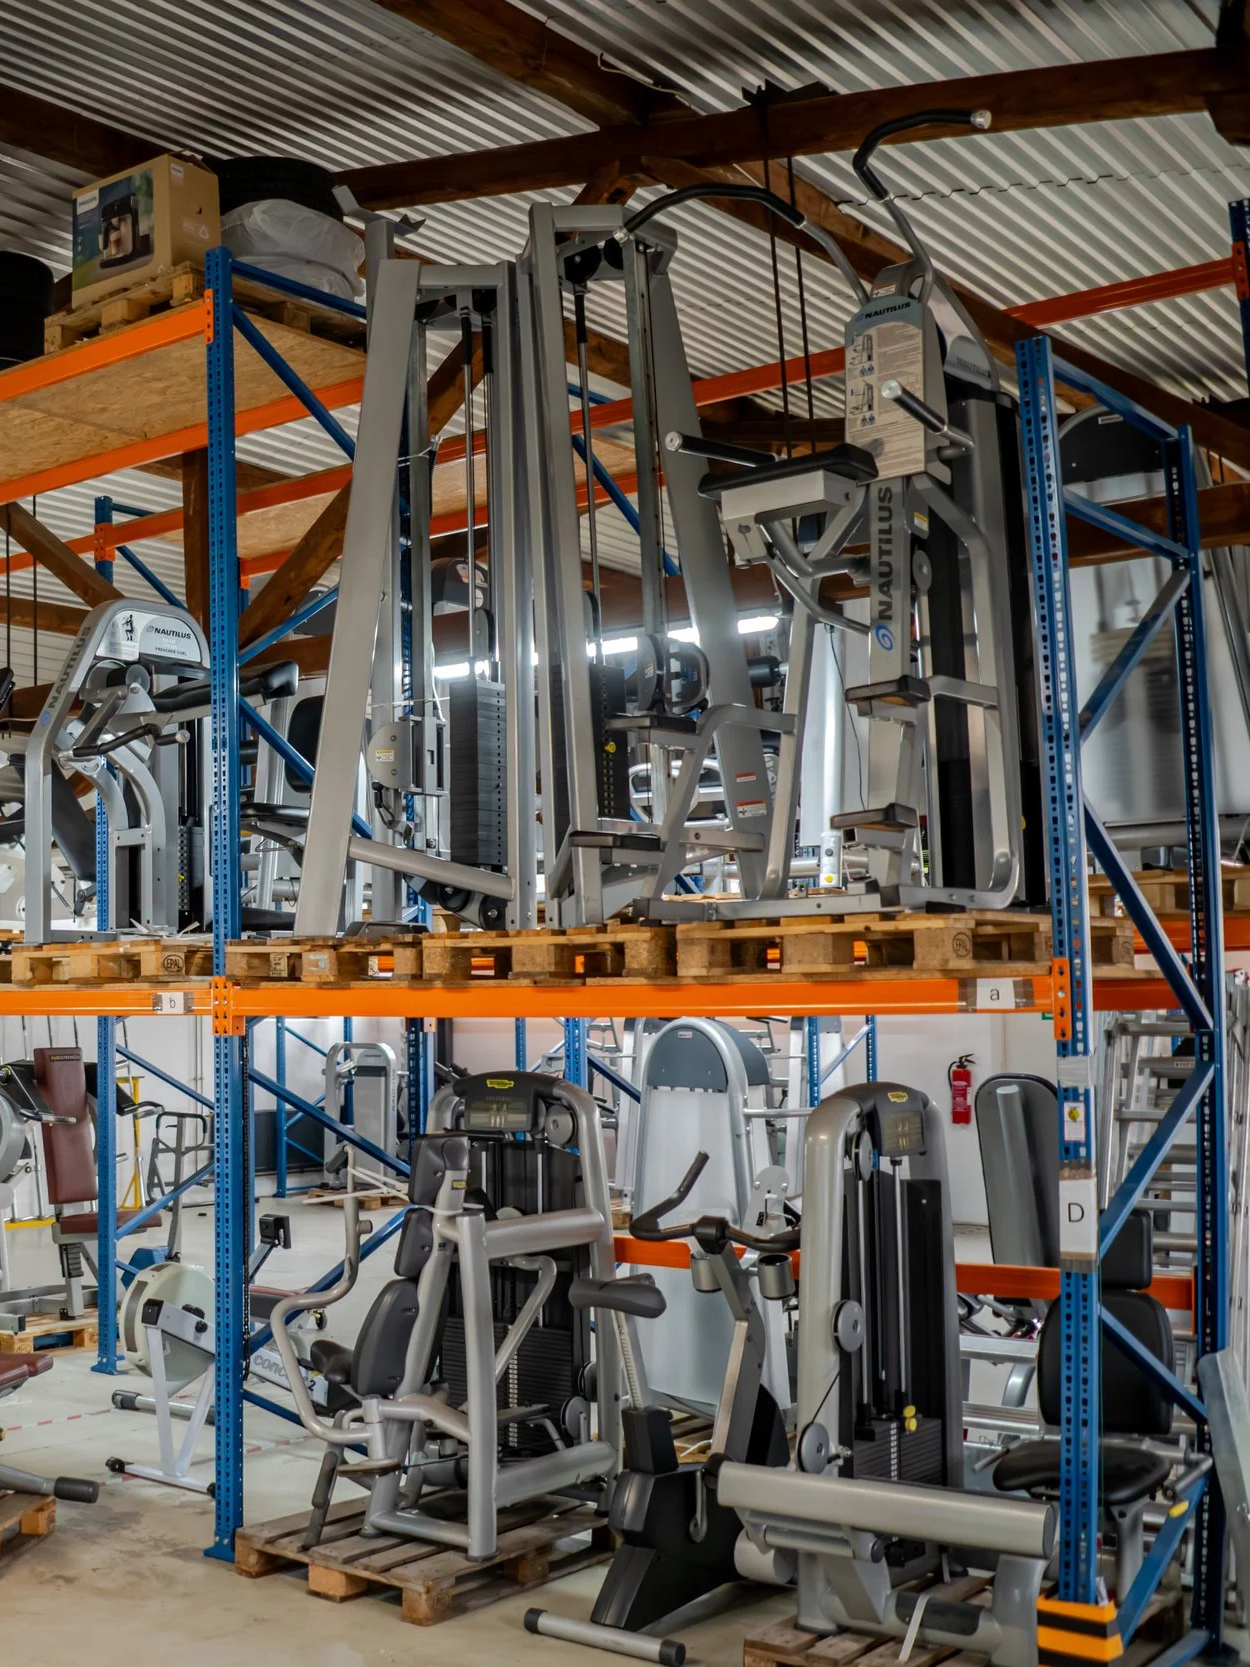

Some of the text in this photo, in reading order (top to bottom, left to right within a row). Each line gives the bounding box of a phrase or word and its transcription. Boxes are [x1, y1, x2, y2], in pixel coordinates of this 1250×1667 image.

[864, 301, 911, 319] NAUTILUS
[878, 486, 893, 621] NAUTILUS
[154, 628, 191, 640] NAUTILUS
[48, 626, 91, 709] NAUTILUS
[166, 958, 182, 969] EPAL
[989, 988, 1000, 1001] a
[169, 997, 176, 1008] b
[1067, 1203, 1085, 1223] D
[308, 1380, 316, 1391] 2
